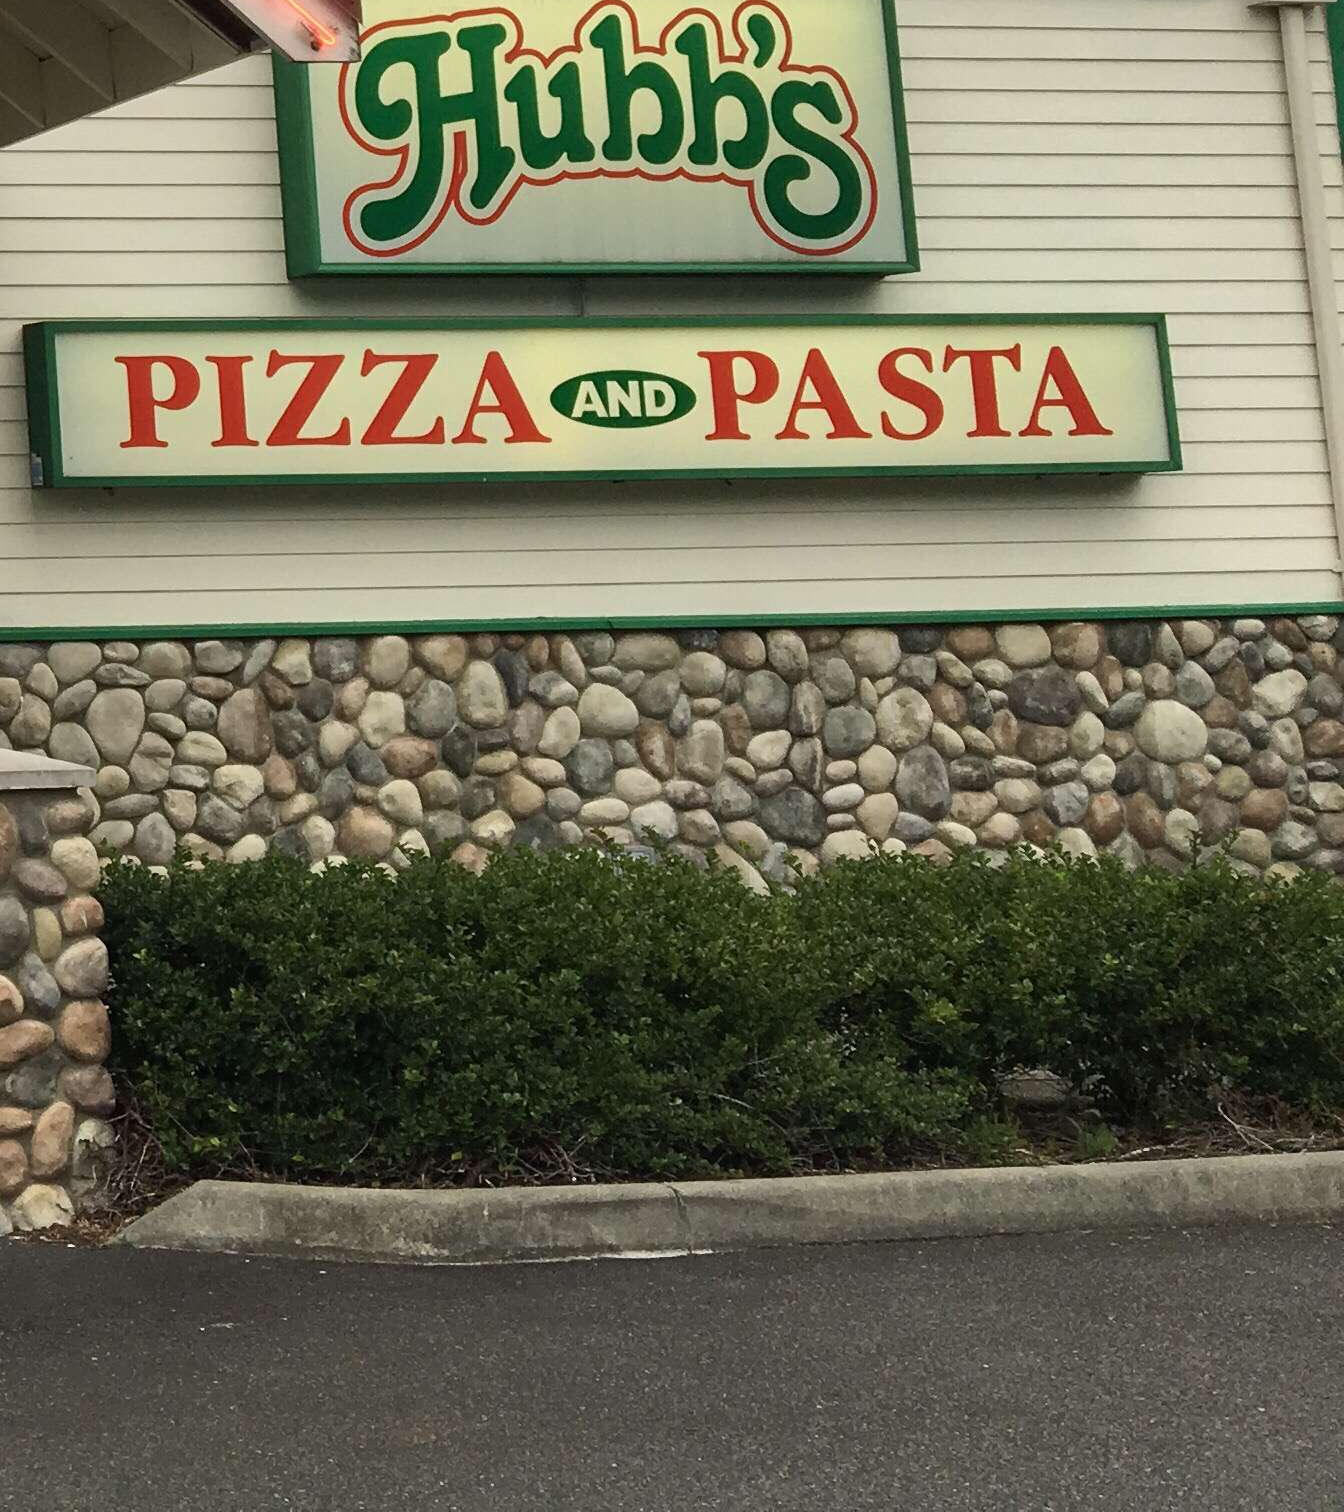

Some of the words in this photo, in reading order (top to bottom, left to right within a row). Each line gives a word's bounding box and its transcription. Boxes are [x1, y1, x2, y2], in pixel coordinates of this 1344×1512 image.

[353, 9, 864, 242] Hubb's
[115, 350, 552, 448] PIZZA
[571, 380, 677, 418] AND
[697, 344, 1113, 442] PASTA
